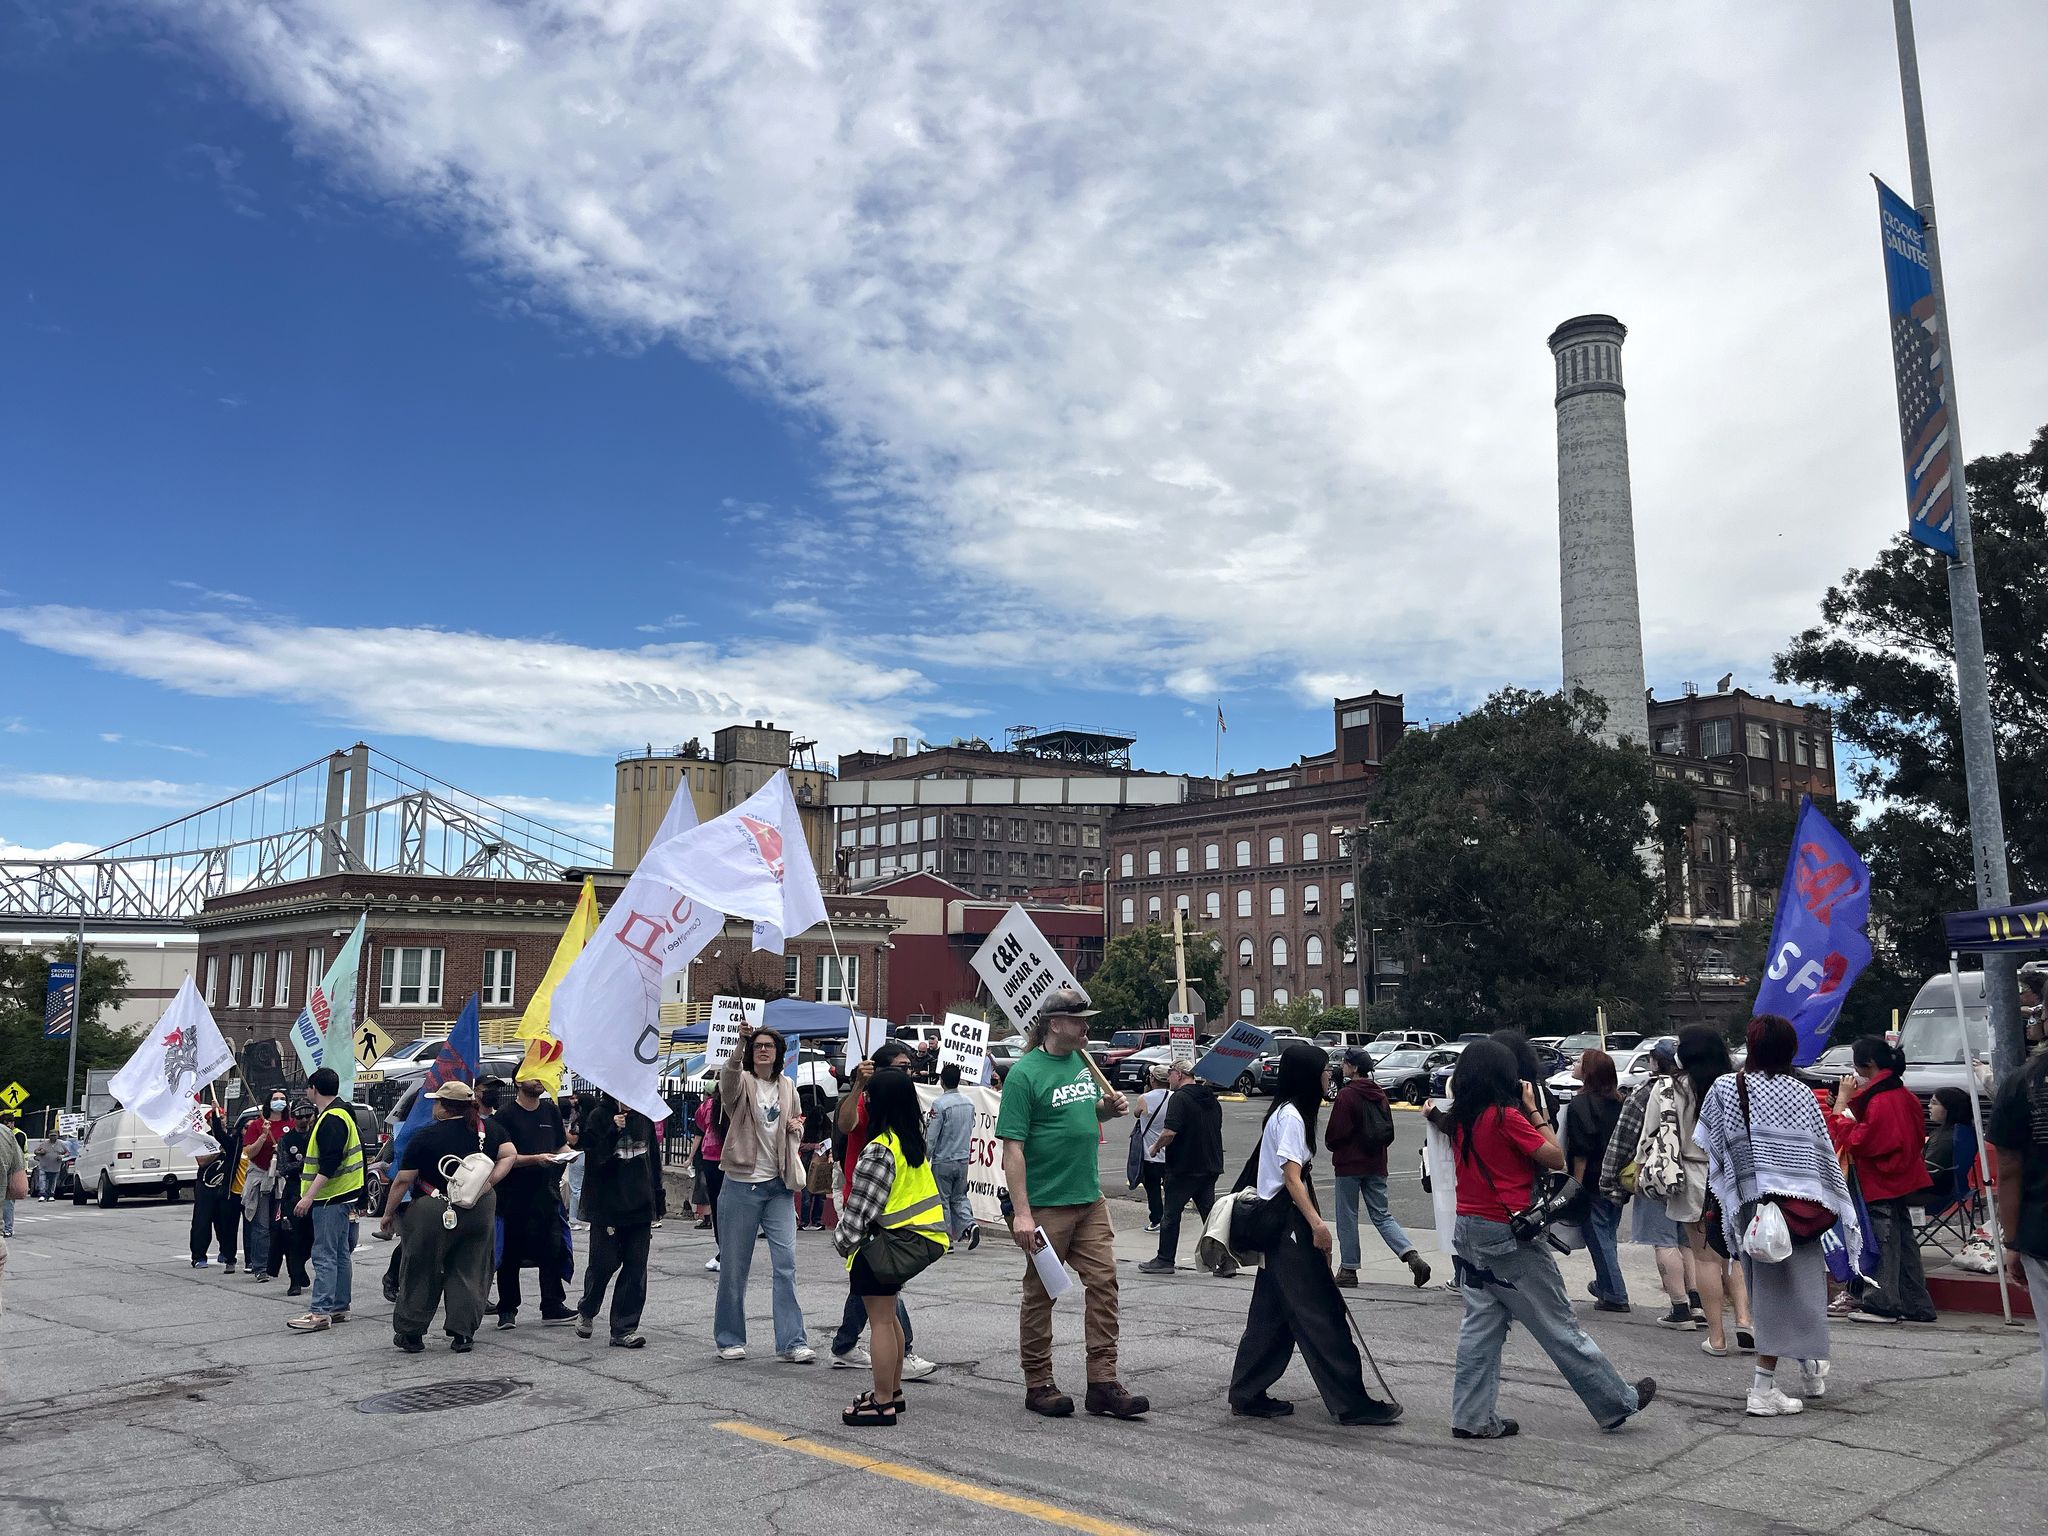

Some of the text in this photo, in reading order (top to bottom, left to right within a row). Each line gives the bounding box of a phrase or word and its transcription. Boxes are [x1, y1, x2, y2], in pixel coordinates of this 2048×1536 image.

[992, 932, 1024, 974] C&H
[1003, 952, 1042, 998] UNFAIR &
[1013, 968, 1055, 1019] BAD FAITH
[746, 1003, 756, 1011] ON
[712, 1024, 725, 1032] FOR
[951, 1023, 982, 1042] C&H
[720, 1036, 740, 1046] FIRIN
[1231, 1027, 1265, 1050] LABOR
[944, 1039, 984, 1058] UNFAIR
[956, 1053, 965, 1063] TO
[358, 1073, 379, 1081] AHEAD
